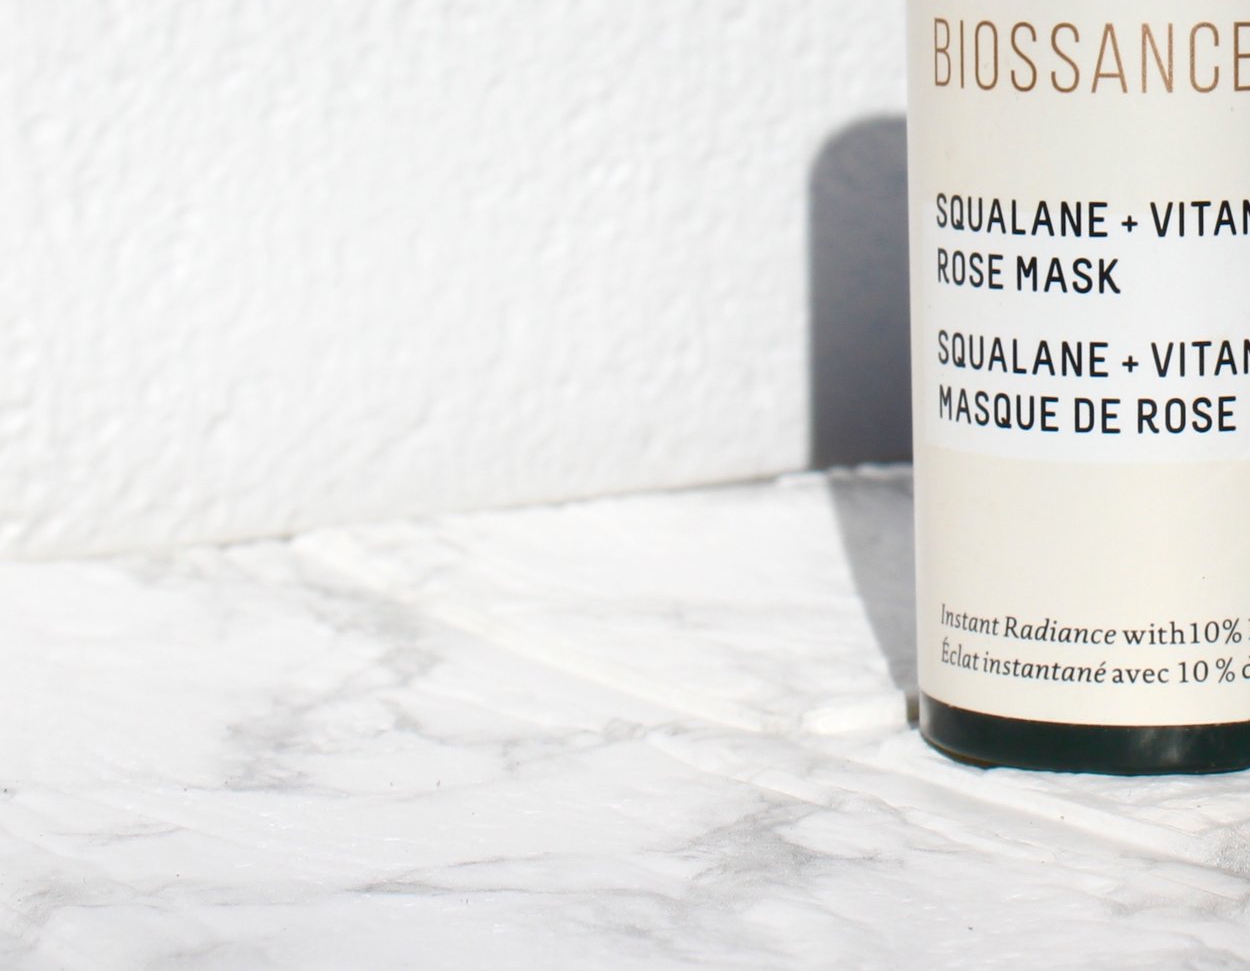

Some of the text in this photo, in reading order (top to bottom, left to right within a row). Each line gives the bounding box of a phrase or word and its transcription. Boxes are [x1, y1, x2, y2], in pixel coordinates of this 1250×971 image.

[936, 193, 1108, 238] SQUALANE
[1121, 215, 1138, 232] +
[937, 248, 1121, 294] ROSE MASK
[938, 329, 1109, 378] SQUALANE
[1122, 355, 1139, 373] +
[939, 384, 1237, 433] MASQUE DE ROSE
[941, 603, 1000, 636] Instant
[1003, 616, 1117, 645] Radiance
[940, 637, 980, 671] Éclat
[983, 651, 1107, 684] instantané
[1111, 667, 1170, 684] avec
